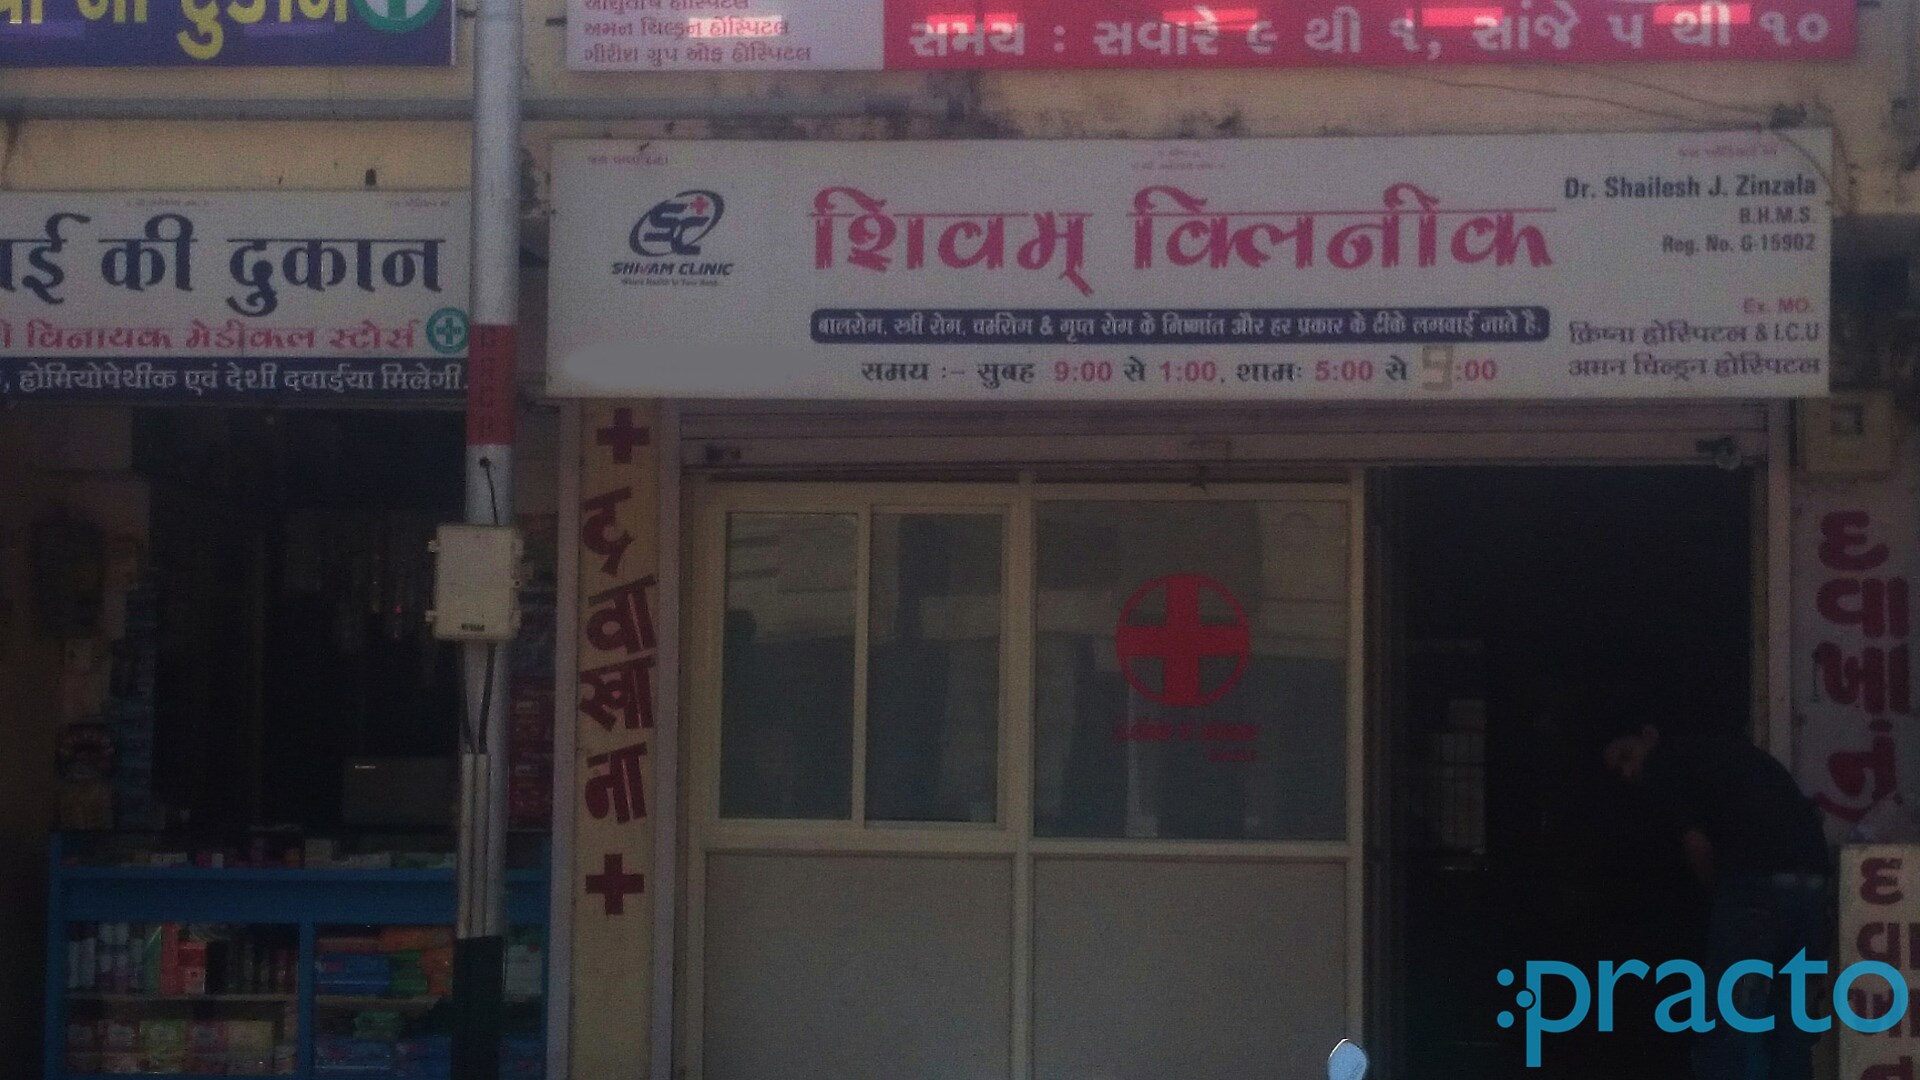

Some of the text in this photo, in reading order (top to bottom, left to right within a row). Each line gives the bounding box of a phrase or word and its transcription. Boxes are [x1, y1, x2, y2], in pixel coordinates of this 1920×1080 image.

[910, 21, 1025, 56] સમય
[1093, 3, 1219, 55] સવારે
[1305, 6, 1360, 54] થી
[1565, 173, 1817, 198] Dr. Shailesh J. Zinzala
[809, 187, 1094, 297] शिवम्
[1662, 234, 1699, 256] Reg.
[1706, 234, 1733, 252] No.
[98, 213, 198, 291] की
[227, 239, 446, 317] दुकान
[611, 262, 735, 276] SHIVAM CLINIC
[27, 319, 172, 350] विनायक
[185, 319, 315, 351] मेडीकल
[1039, 314, 1054, 335] &
[1101, 312, 1132, 335] रोग
[1140, 311, 1156, 335] के
[1231, 311, 1264, 335] और
[1270, 318, 1291, 337] हर
[1297, 317, 1344, 338] प्रकार
[1350, 310, 1367, 335] के
[1481, 309, 1519, 335] जाते
[1755, 322, 1768, 341] &
[184, 361, 218, 396] एवं
[226, 360, 279, 391] देशी
[861, 362, 930, 381] समय
[977, 362, 1036, 389] सुबह
[1054, 361, 1114, 382] 9:00
[1122, 355, 1146, 382] से
[1315, 360, 1373, 382] 5:00
[1385, 354, 1408, 382] से
